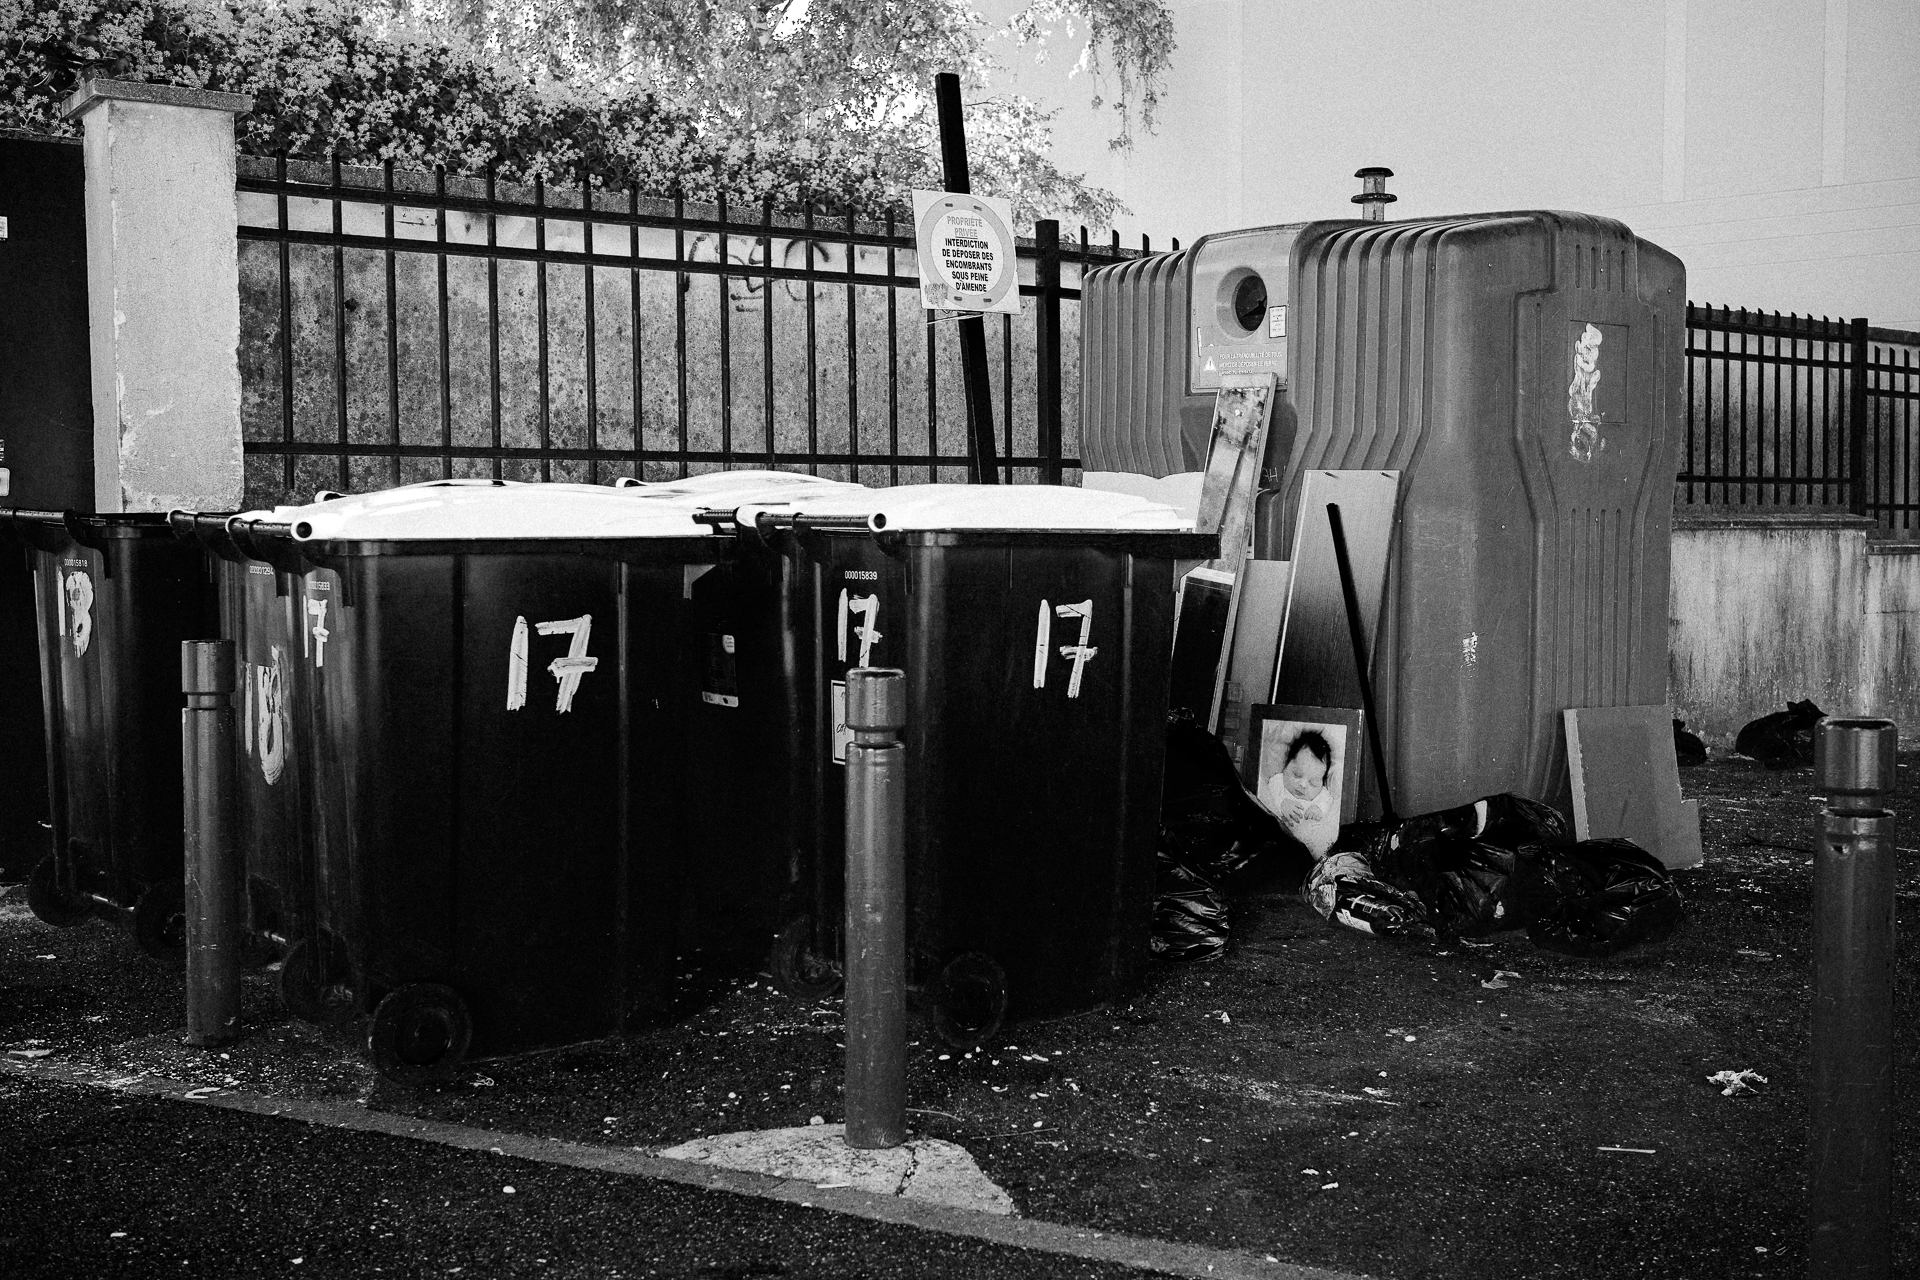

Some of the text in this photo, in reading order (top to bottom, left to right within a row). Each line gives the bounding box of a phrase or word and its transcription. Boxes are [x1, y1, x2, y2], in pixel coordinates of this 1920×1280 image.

[944, 238, 989, 250] INTERDICTION
[942, 248, 994, 261] DE DÉPOSER DES
[945, 259, 992, 271] ENCOMBRANTS
[952, 271, 989, 282] SOUS PEINE
[955, 282, 987, 293] D'AMENDE
[844, 570, 878, 580] 000015839
[303, 594, 330, 668] 17
[837, 587, 883, 668] 17
[1033, 599, 1098, 698] 17
[506, 613, 599, 714] 17
